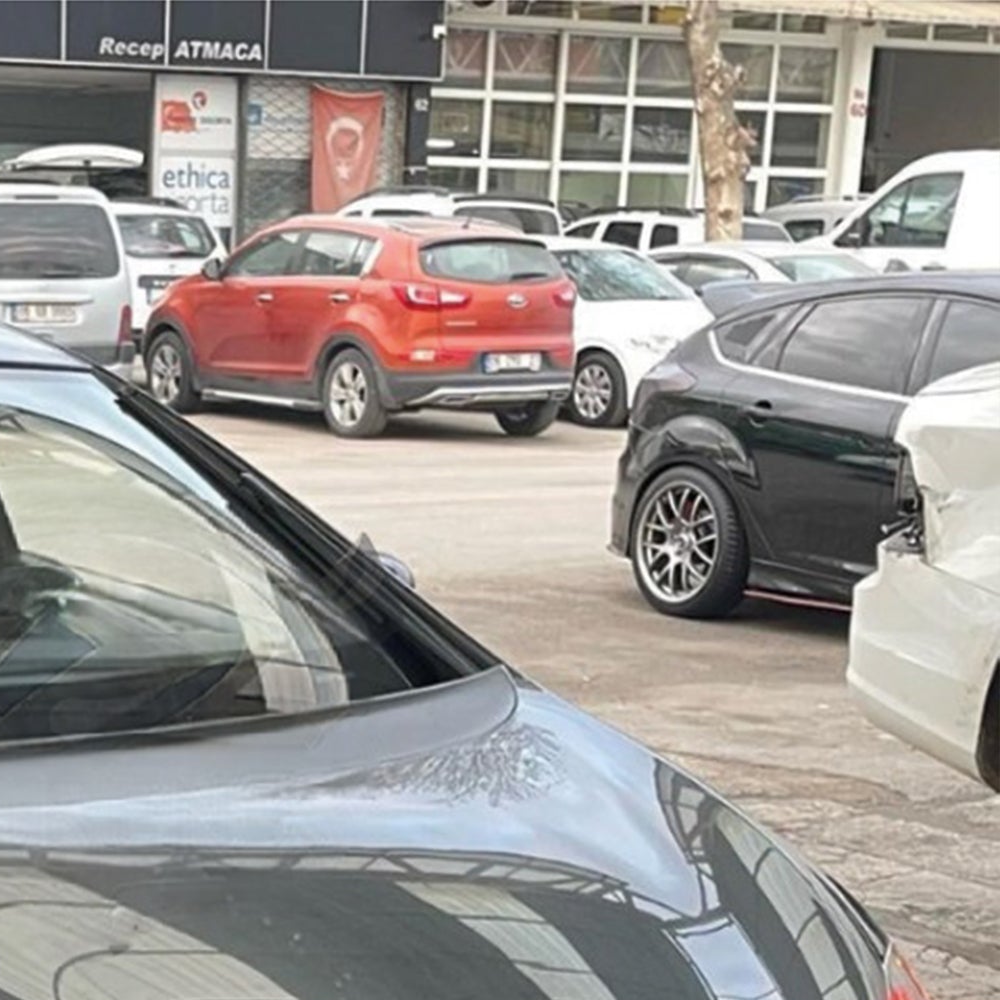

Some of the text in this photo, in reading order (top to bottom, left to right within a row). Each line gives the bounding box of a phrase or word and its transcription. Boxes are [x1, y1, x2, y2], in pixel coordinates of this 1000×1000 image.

[99, 37, 262, 61] Recep ATMACA
[162, 161, 230, 189] ethica
